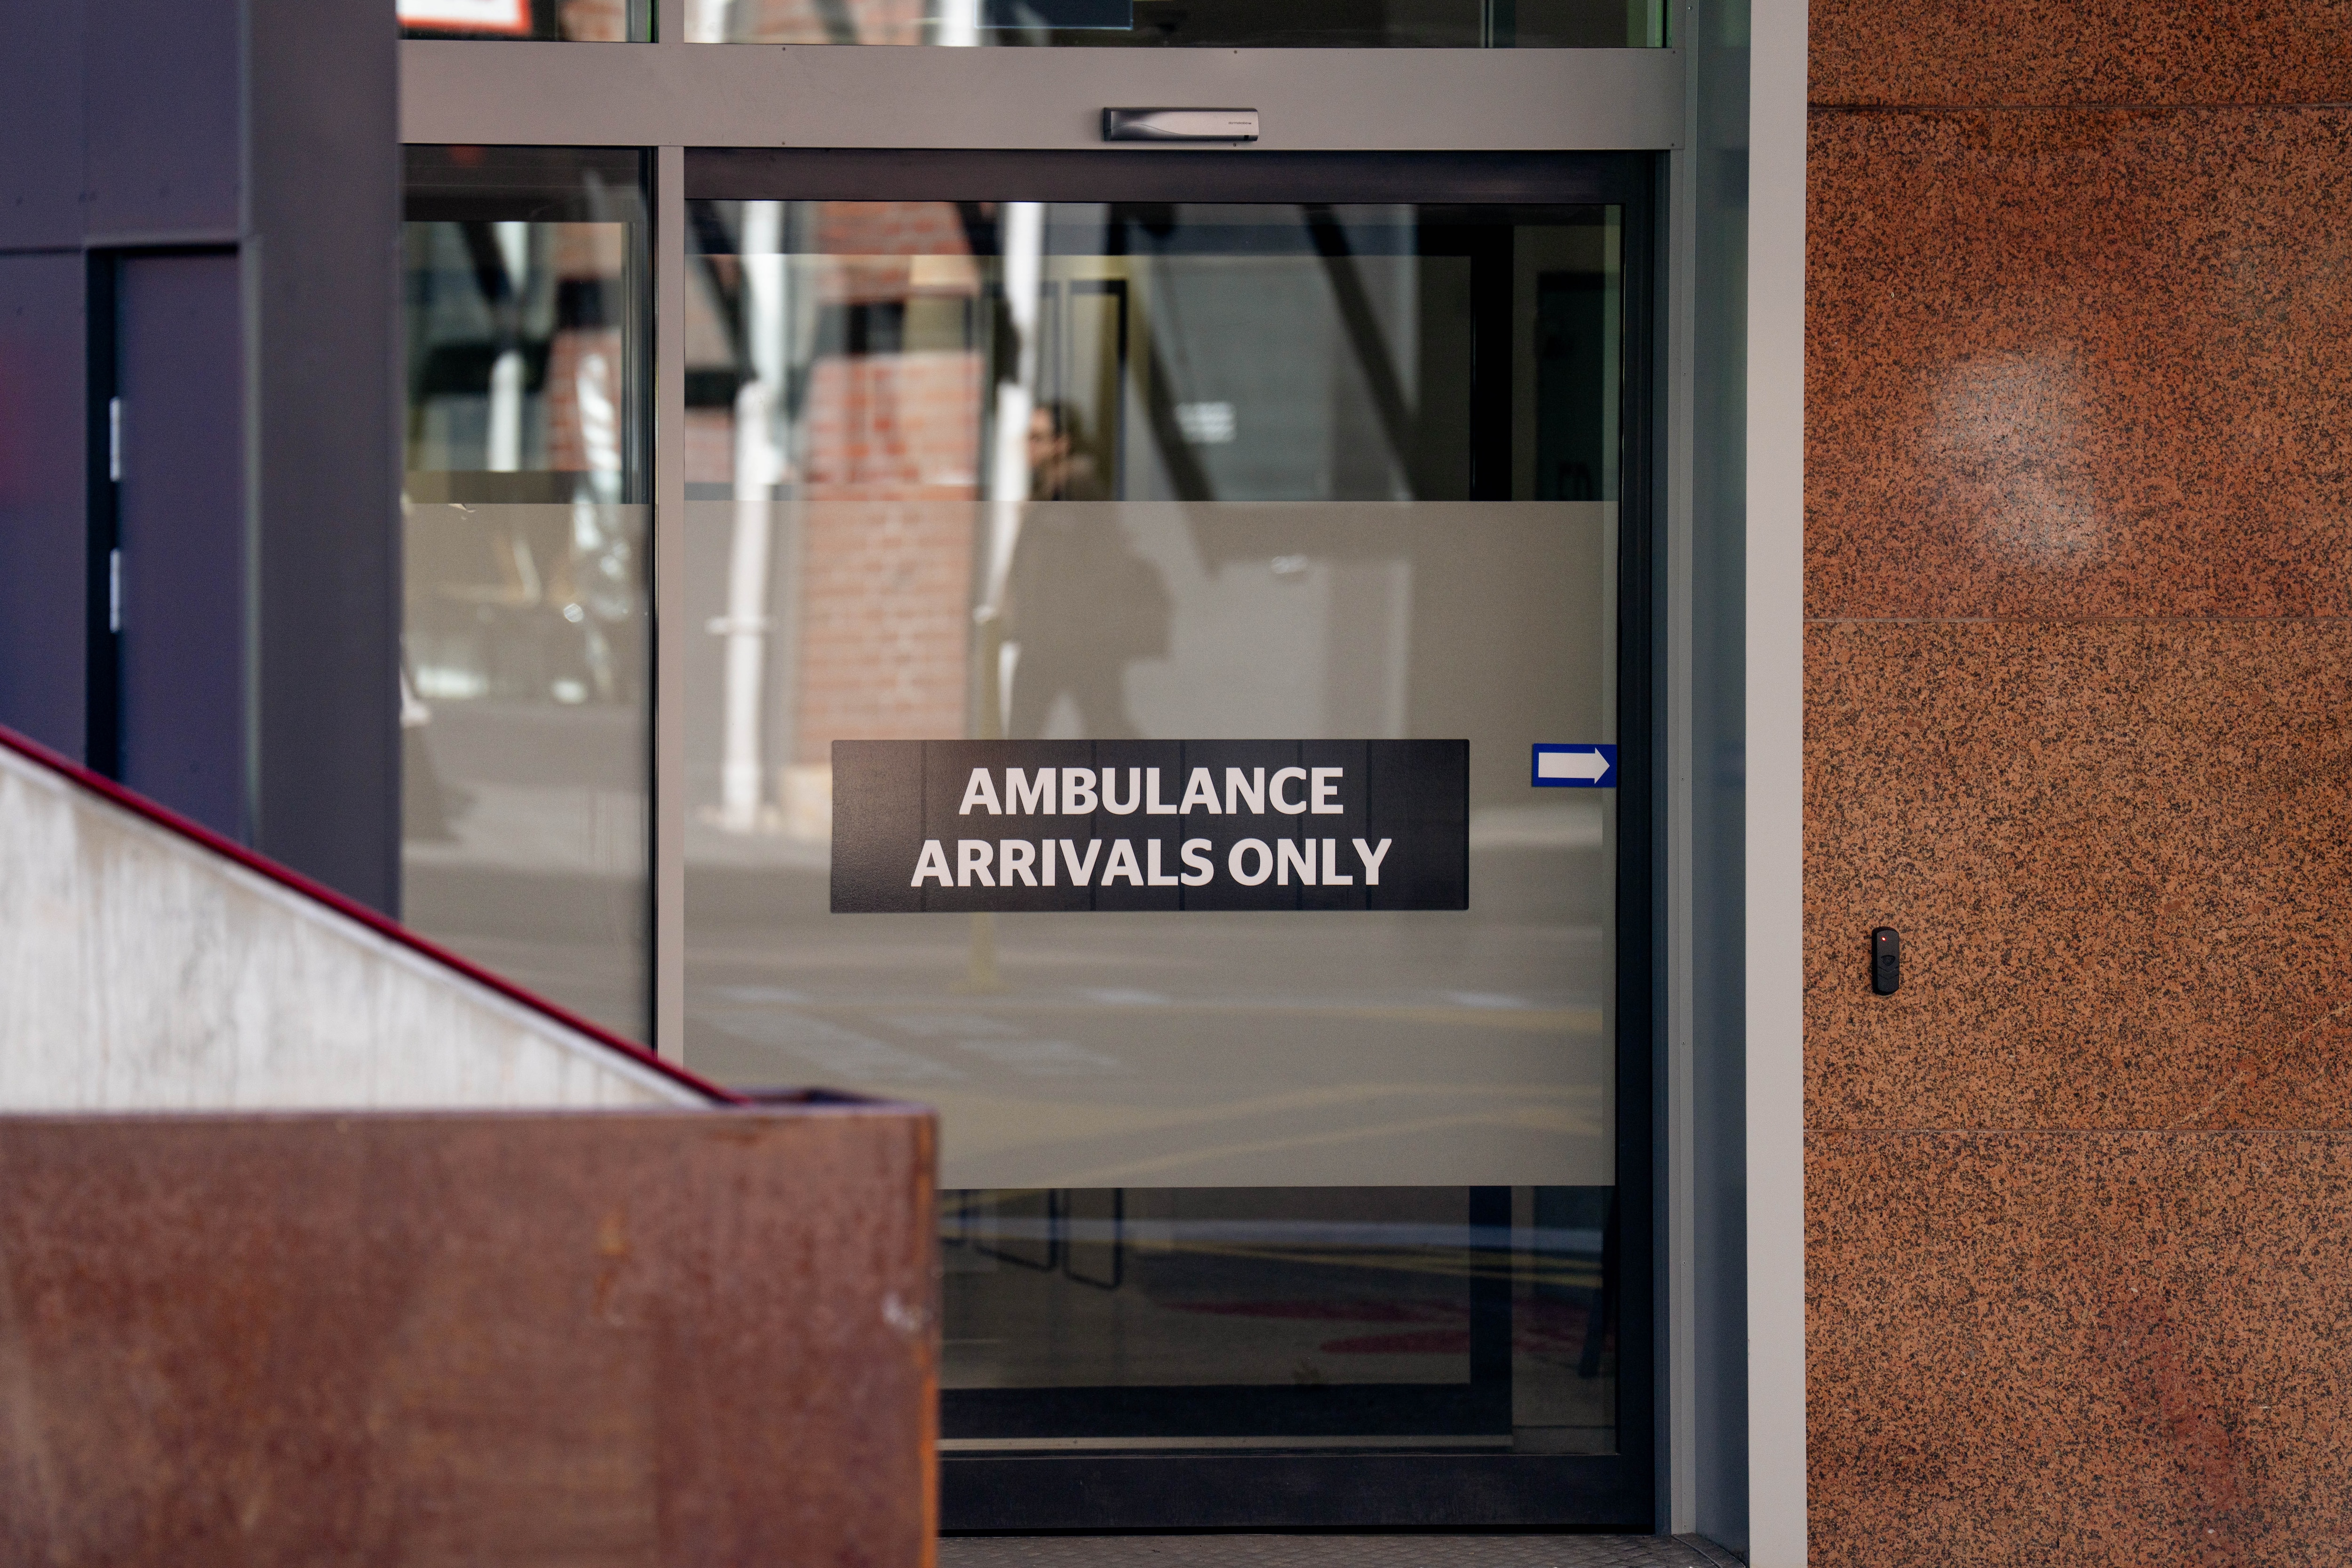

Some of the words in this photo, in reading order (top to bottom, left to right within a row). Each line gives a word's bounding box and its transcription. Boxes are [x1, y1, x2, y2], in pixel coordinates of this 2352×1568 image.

[959, 767, 1343, 815] AMBULANCE
[911, 838, 1215, 887] ARRIVALS
[1228, 838, 1392, 886] ONLY
